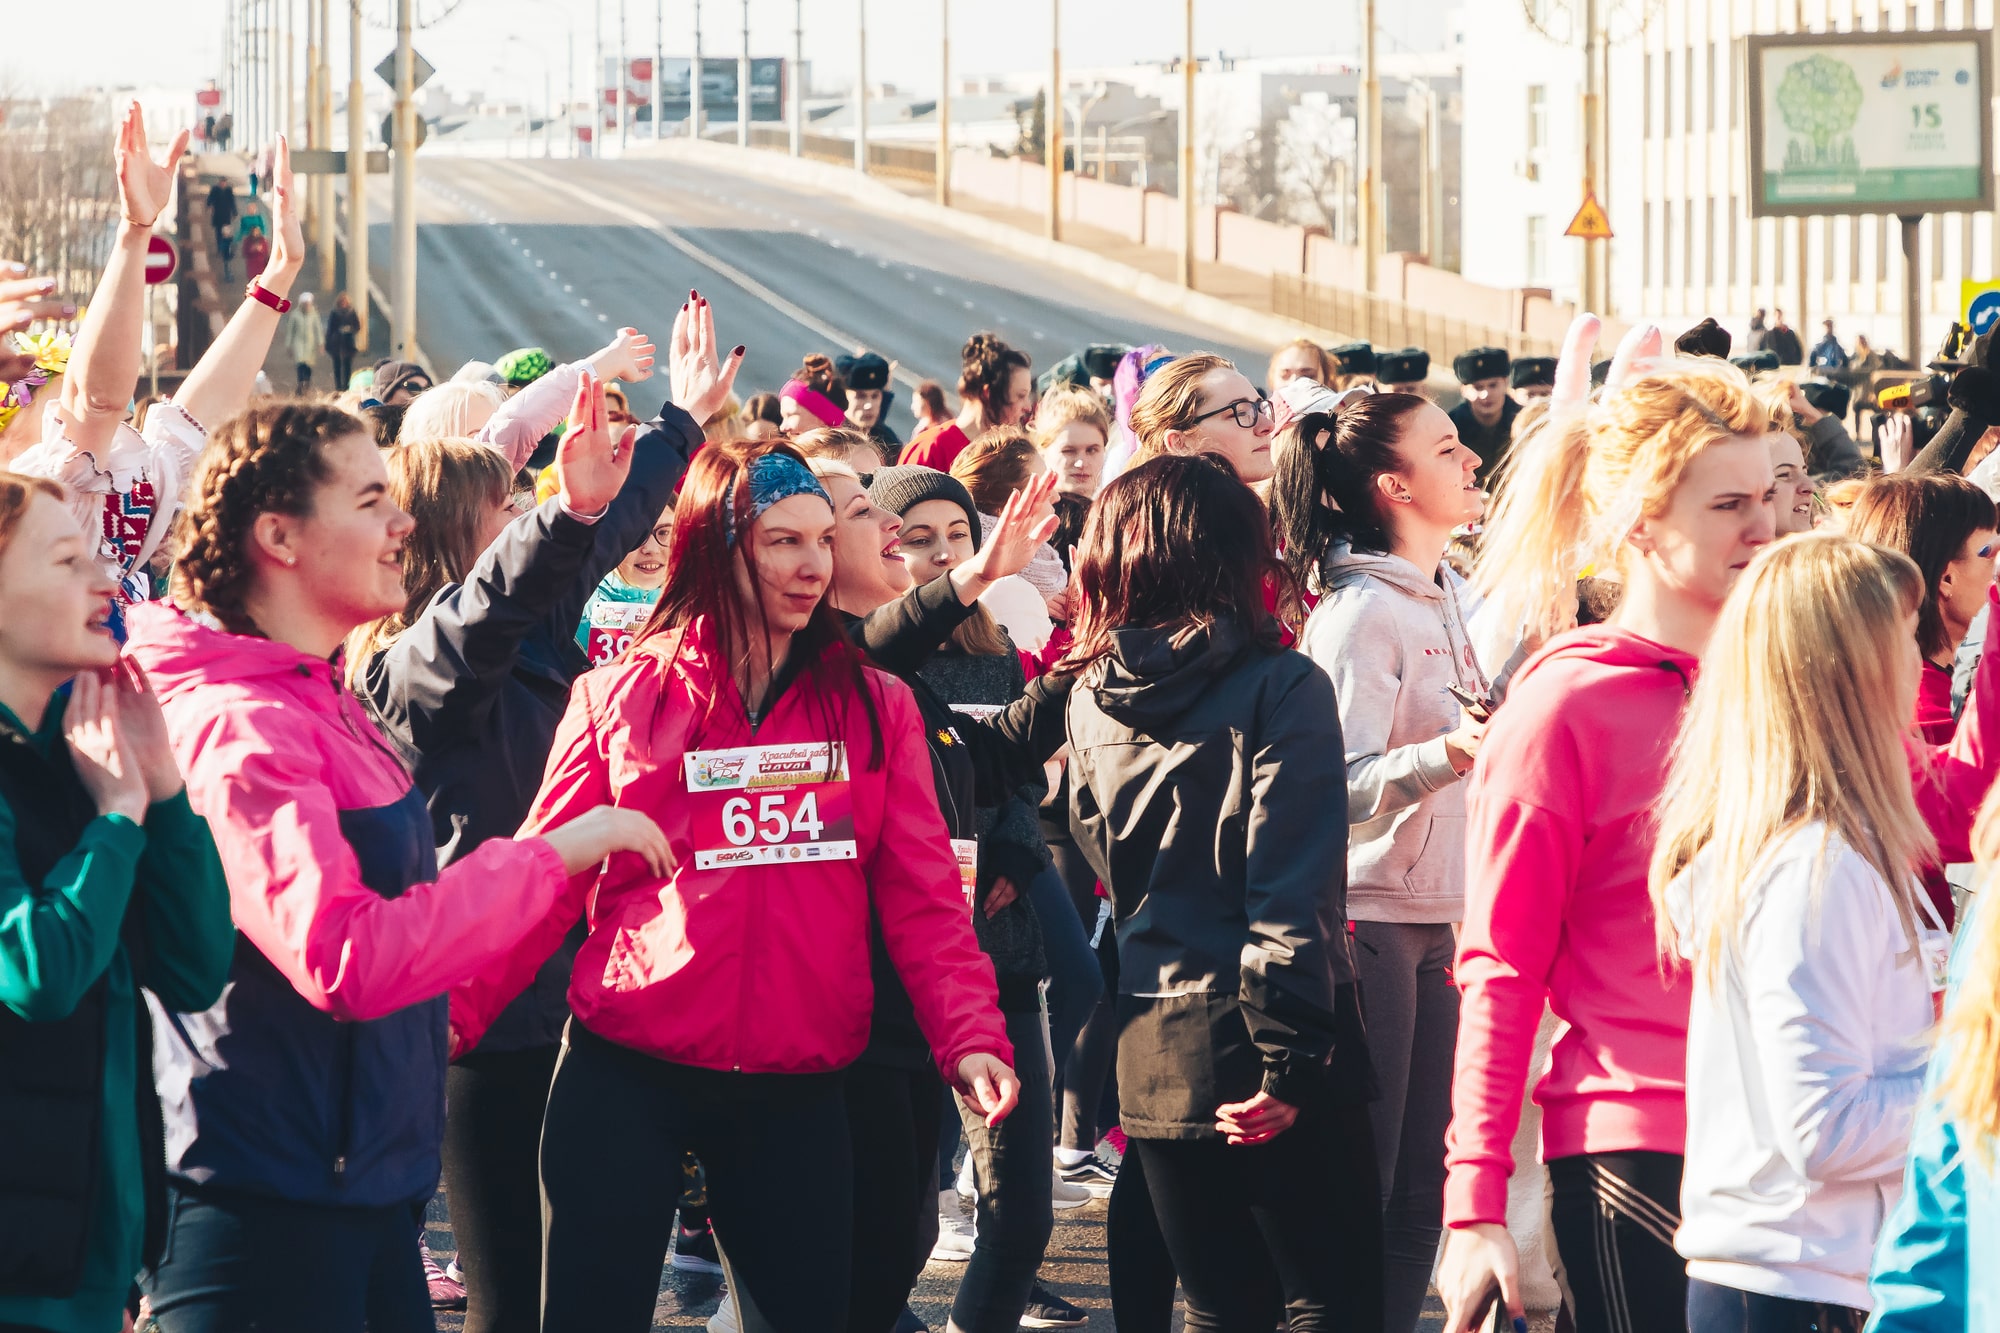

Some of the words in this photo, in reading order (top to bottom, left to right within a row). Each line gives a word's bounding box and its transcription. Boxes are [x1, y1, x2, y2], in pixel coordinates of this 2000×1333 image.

[1911, 102, 1943, 129] 15
[760, 747, 808, 764] Красивый
[809, 744, 830, 762] забе
[721, 791, 825, 847] 654
